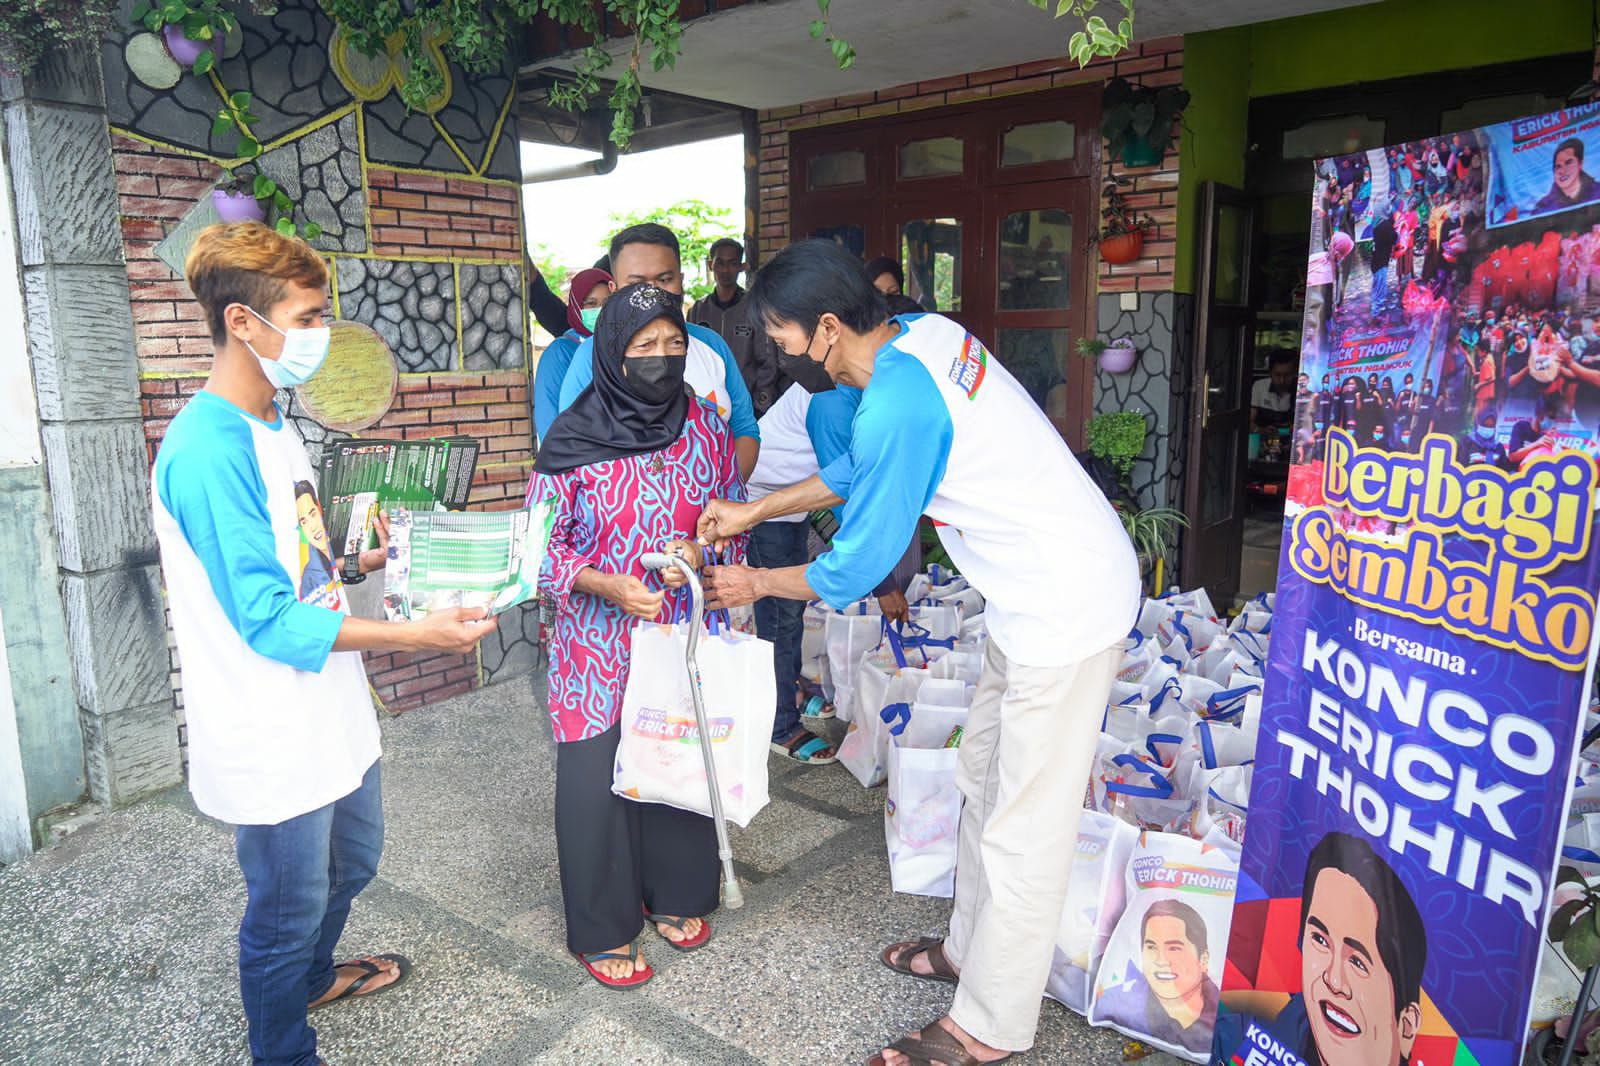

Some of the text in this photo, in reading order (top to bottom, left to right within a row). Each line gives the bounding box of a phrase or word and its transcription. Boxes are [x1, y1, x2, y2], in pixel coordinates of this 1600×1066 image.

[1518, 111, 1561, 137] ERICK
[1358, 338, 1410, 359] THOHIR
[1328, 437, 1584, 560] Berbagi
[1301, 517, 1591, 655] Sembako
[1354, 617, 1467, 676] Bersama
[638, 719, 679, 736] ERICK
[1302, 628, 1556, 776] KONCO
[1308, 687, 1526, 841] ERICK
[1276, 729, 1544, 929] THOHIR
[1138, 868, 1235, 890] ERICK THOHIR
